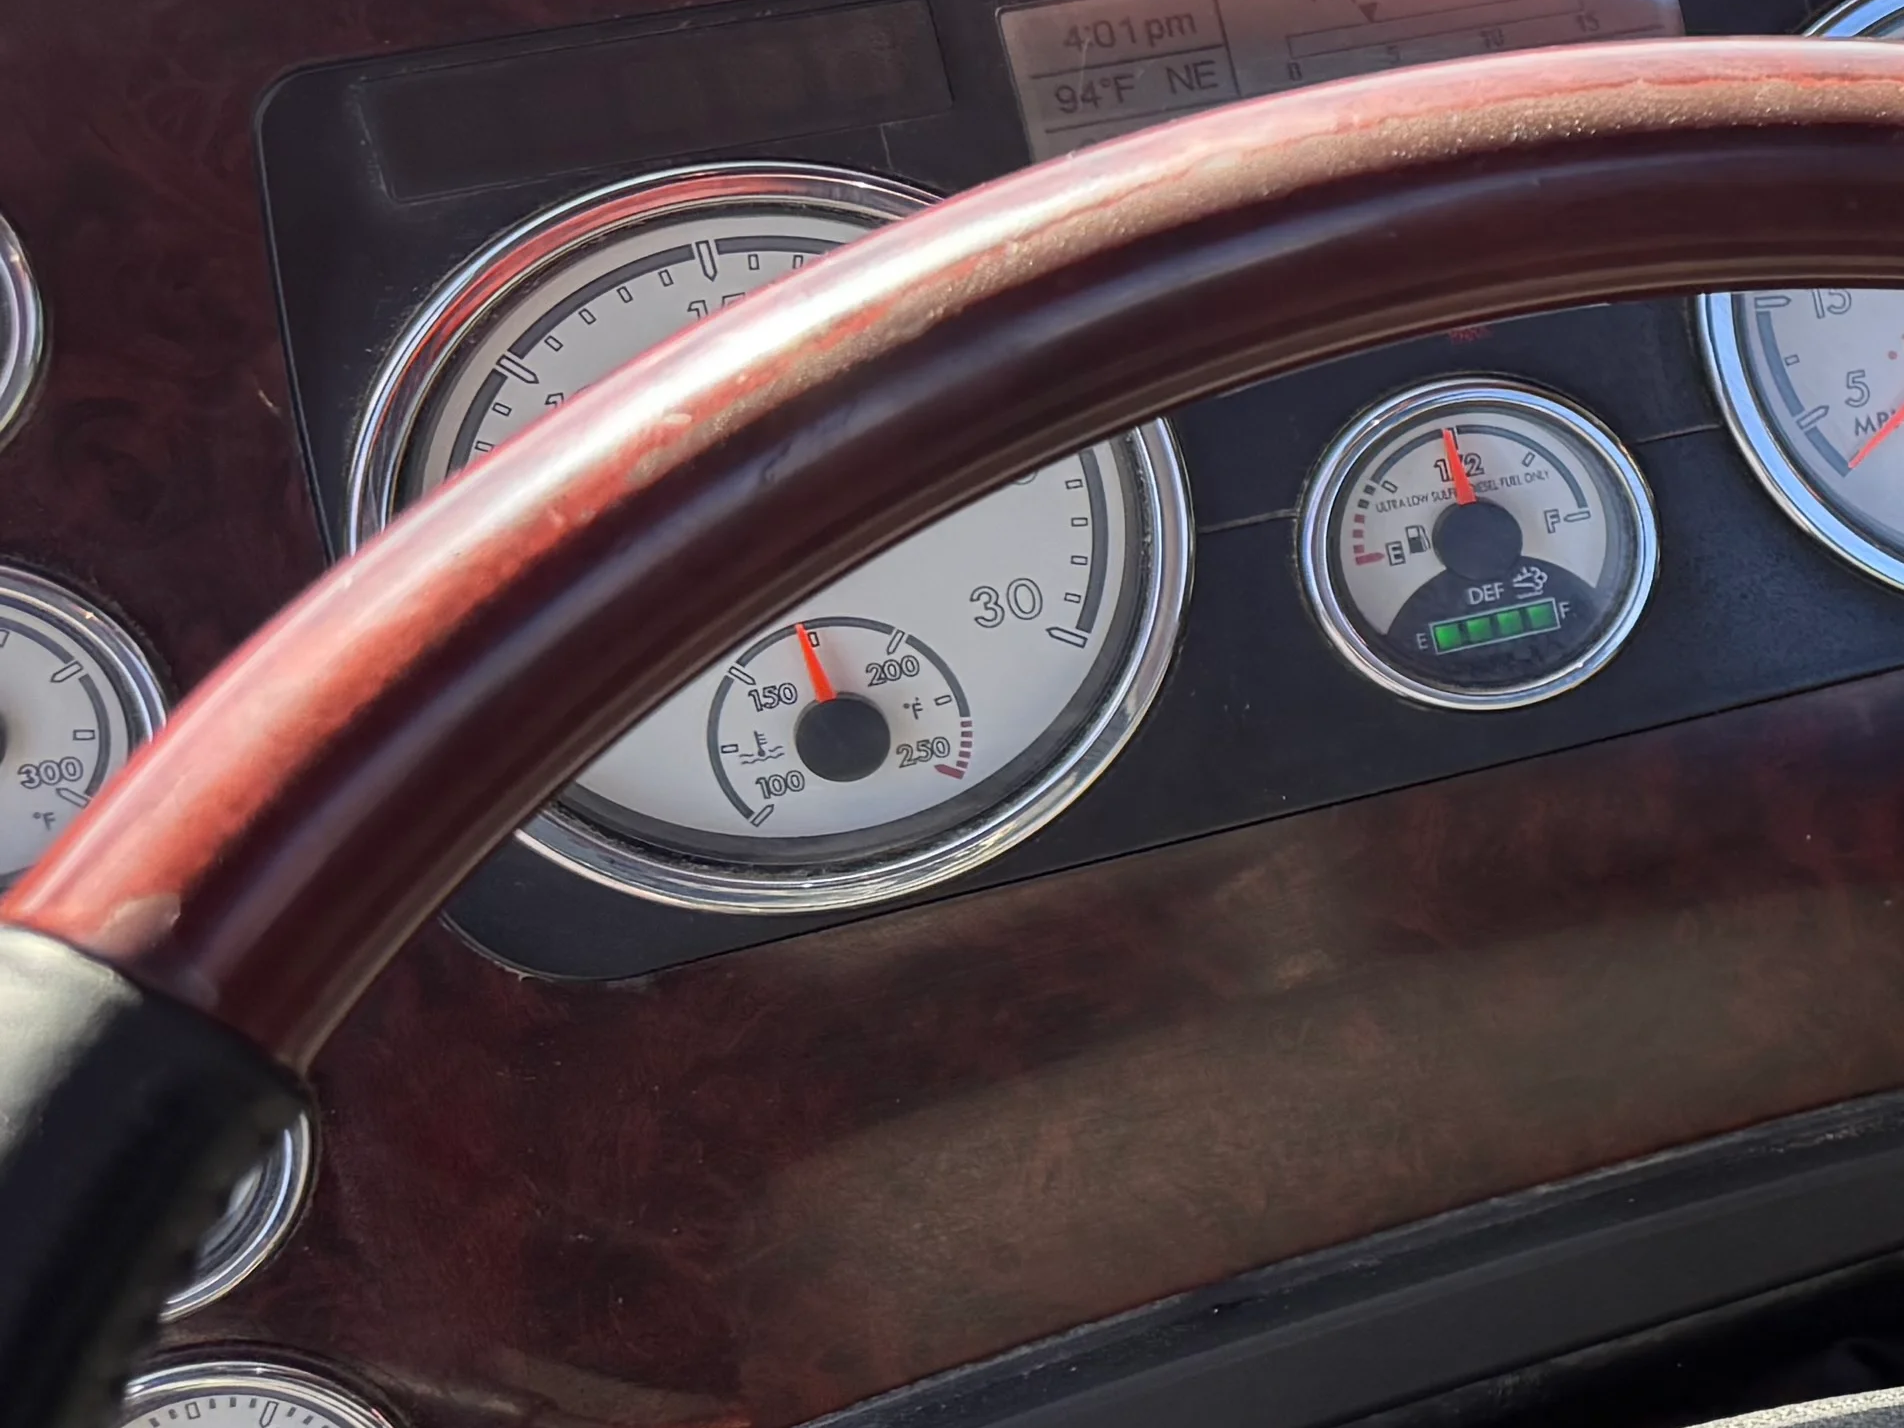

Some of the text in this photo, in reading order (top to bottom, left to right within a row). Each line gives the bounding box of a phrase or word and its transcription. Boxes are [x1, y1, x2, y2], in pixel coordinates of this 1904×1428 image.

[1480, 26, 1506, 49] 10
[1575, 13, 1600, 34] 15
[1054, 61, 1217, 115] 94°F NE
[1844, 369, 1871, 408] 5
[1376, 498, 1405, 513] ULTRA
[1407, 493, 1429, 507] LOW
[1500, 474, 1522, 488] FUEL
[1525, 470, 1551, 484] ONLY
[1544, 508, 1560, 534] F
[1384, 540, 1406, 566] E
[969, 577, 1044, 629] 30
[1468, 582, 1505, 606] DEF
[1558, 601, 1571, 621] F
[1416, 632, 1428, 651] E
[865, 654, 921, 687] 200
[747, 681, 799, 713] 150
[902, 696, 923, 721] °F
[896, 735, 951, 769] 250
[17, 756, 84, 789] 300
[754, 769, 806, 800] 100
[32, 809, 56, 833] °F
